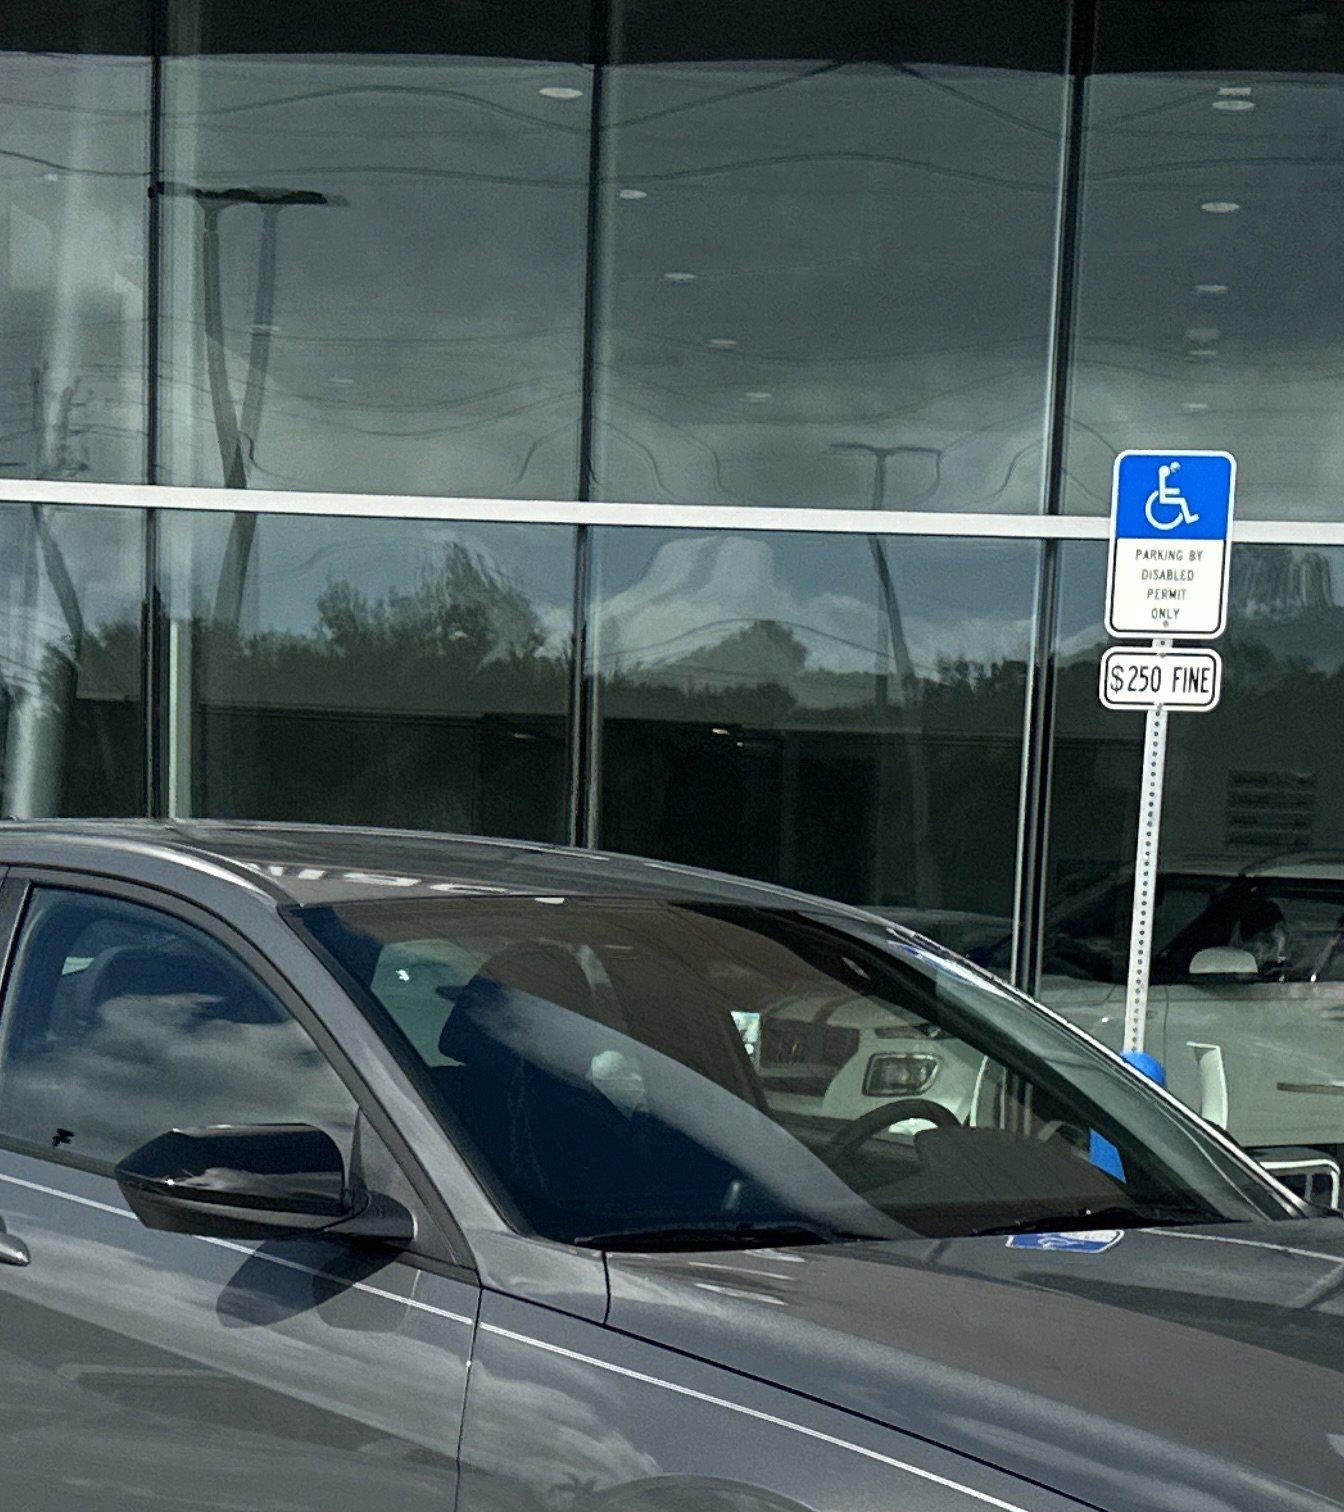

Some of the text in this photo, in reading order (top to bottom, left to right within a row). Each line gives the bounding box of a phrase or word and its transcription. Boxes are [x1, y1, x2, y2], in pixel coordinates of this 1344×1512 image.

[1135, 549, 1204, 562] PARKING BY
[1141, 569, 1194, 581] DISABLED
[1147, 588, 1186, 600] PERMIT
[1151, 607, 1180, 620] ONLY
[1110, 663, 1210, 694] $250 FINE
